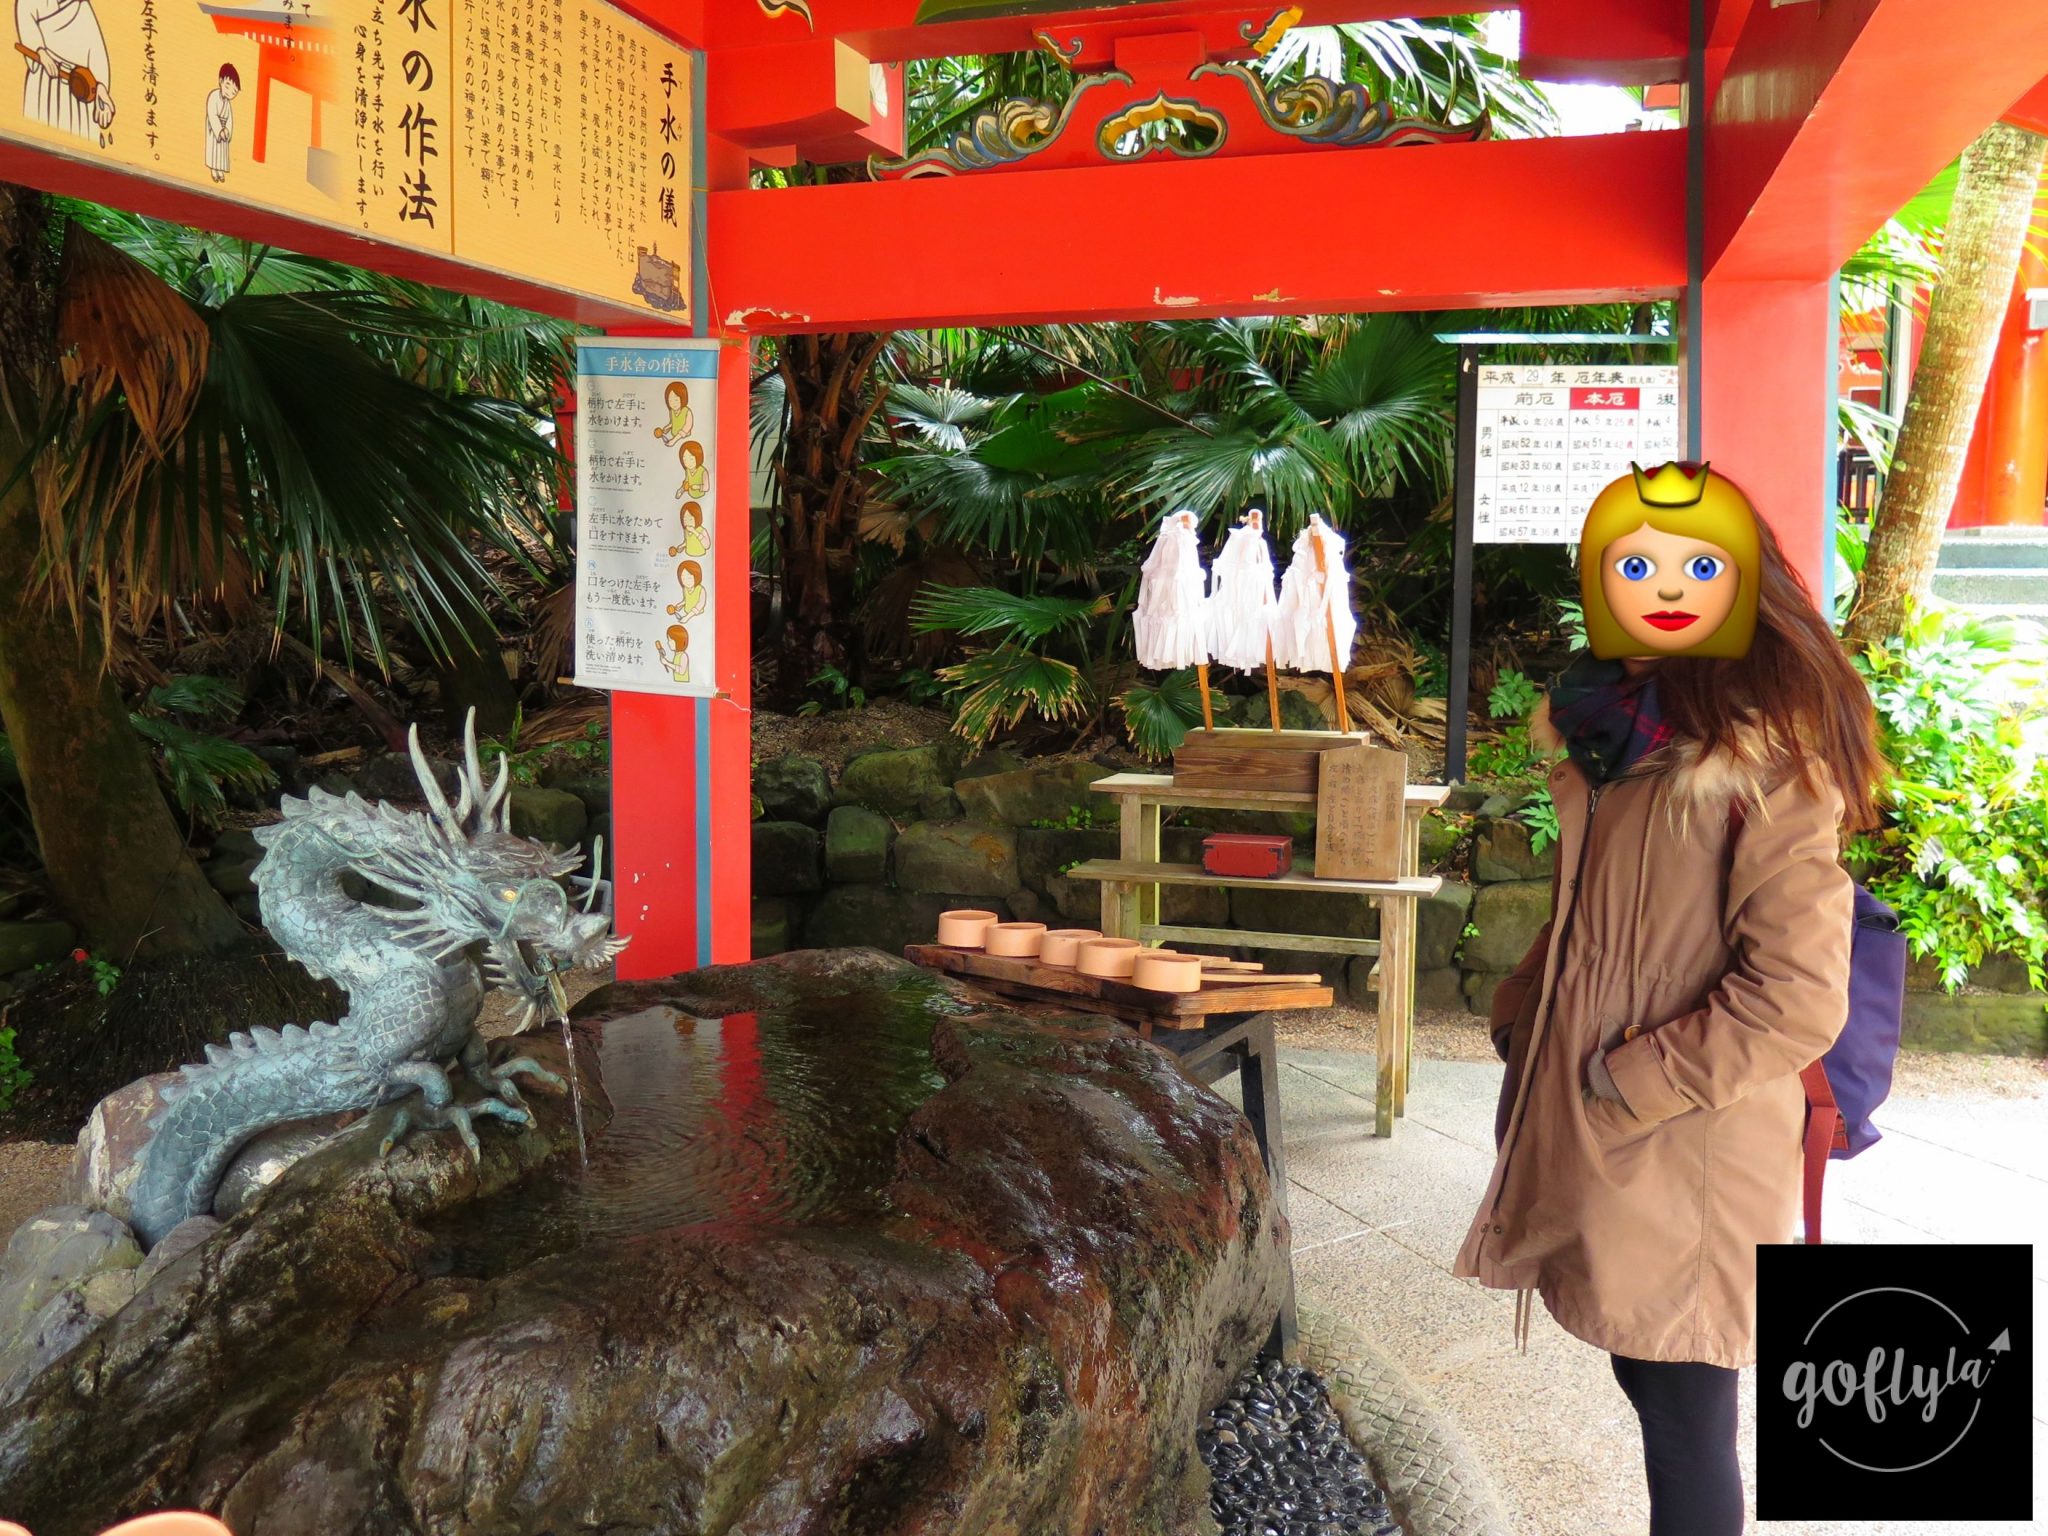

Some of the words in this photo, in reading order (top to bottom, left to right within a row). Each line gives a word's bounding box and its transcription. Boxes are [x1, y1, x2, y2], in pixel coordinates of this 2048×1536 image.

[354, 24, 368, 229] 心身を清浄にします。
[658, 62, 679, 228] 手水の儀
[605, 355, 690, 374] 手水舎の作法
[1514, 391, 1555, 406] 前厄
[1584, 391, 1626, 406] 本厄
[1480, 426, 1492, 458] 男性
[1478, 493, 1491, 524] 女性
